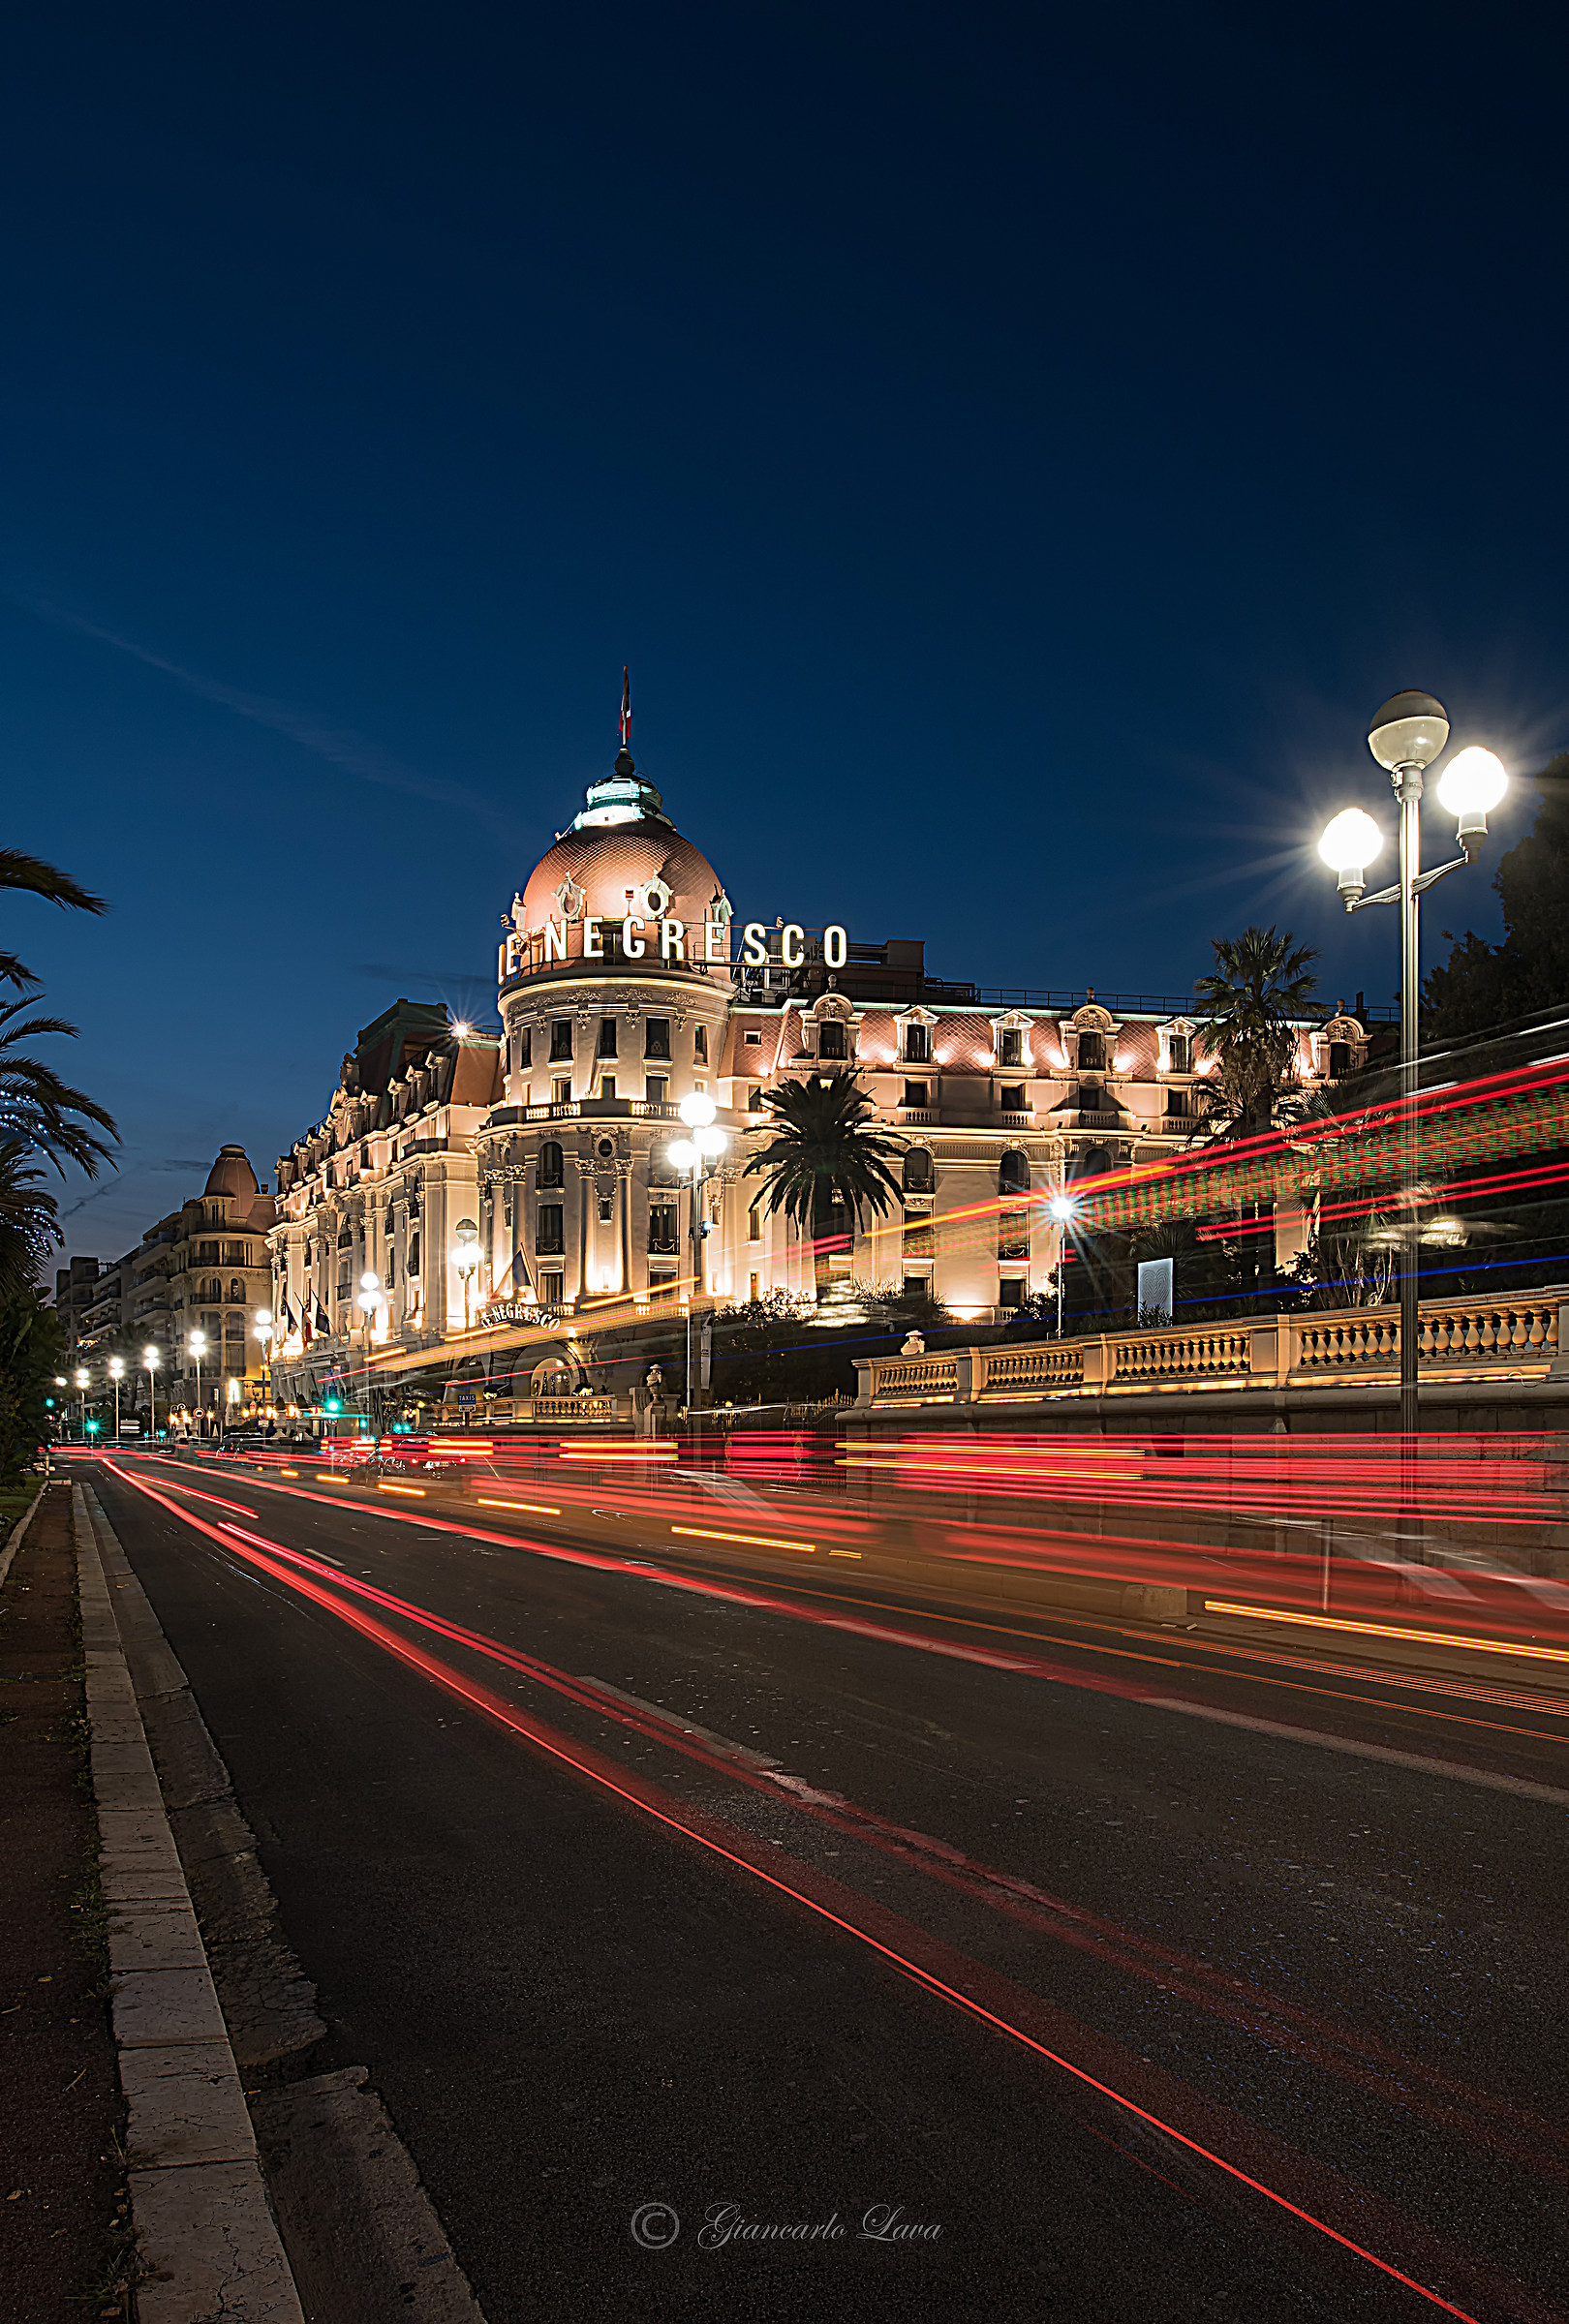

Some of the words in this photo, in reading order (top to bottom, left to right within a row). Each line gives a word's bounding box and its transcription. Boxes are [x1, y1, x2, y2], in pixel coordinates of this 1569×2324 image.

[498, 932, 519, 985] LE
[544, 915, 847, 968] NEGRESCO
[491, 1302, 561, 1330] NEGRESCO
